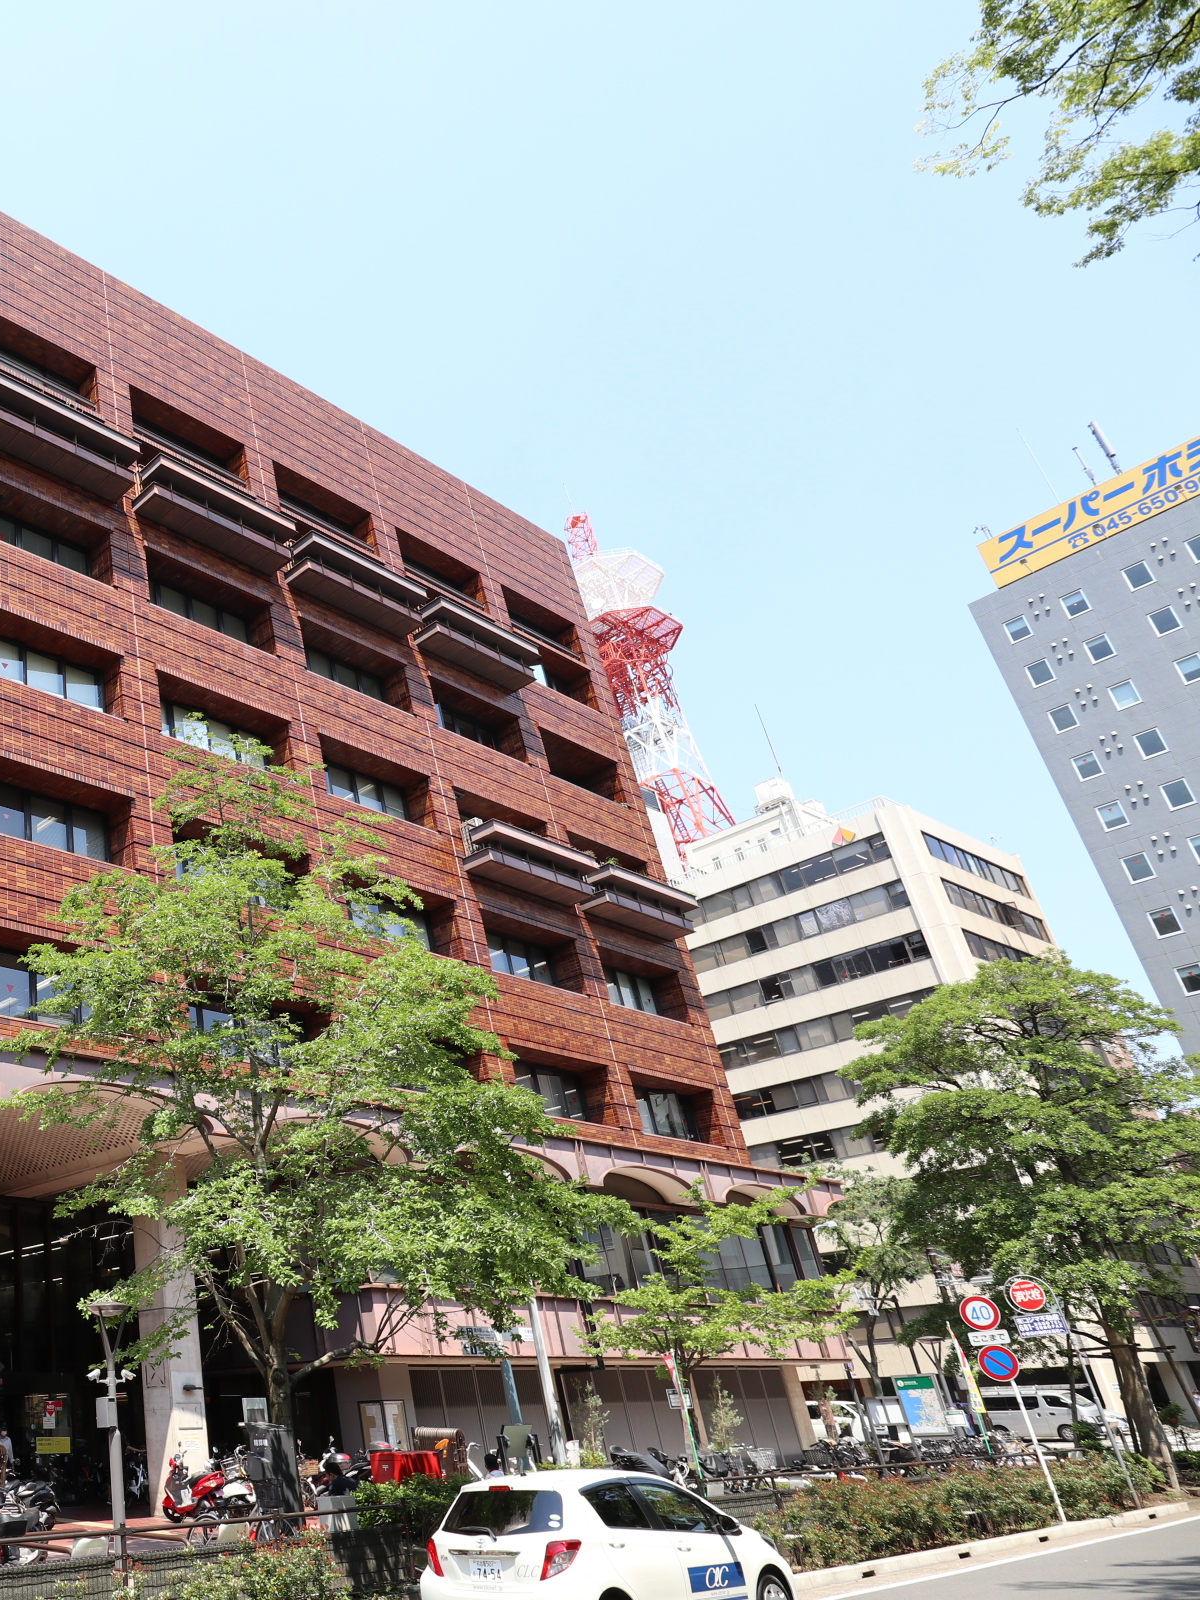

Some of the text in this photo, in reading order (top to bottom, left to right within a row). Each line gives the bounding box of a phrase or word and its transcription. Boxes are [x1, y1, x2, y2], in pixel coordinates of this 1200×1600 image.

[1013, 1288, 1043, 1303] 消火栓
[971, 1305, 991, 1321] 40
[971, 1333, 1005, 1343] ここまで
[476, 1567, 501, 1580] 74-54
[517, 1564, 540, 1578] CLC
